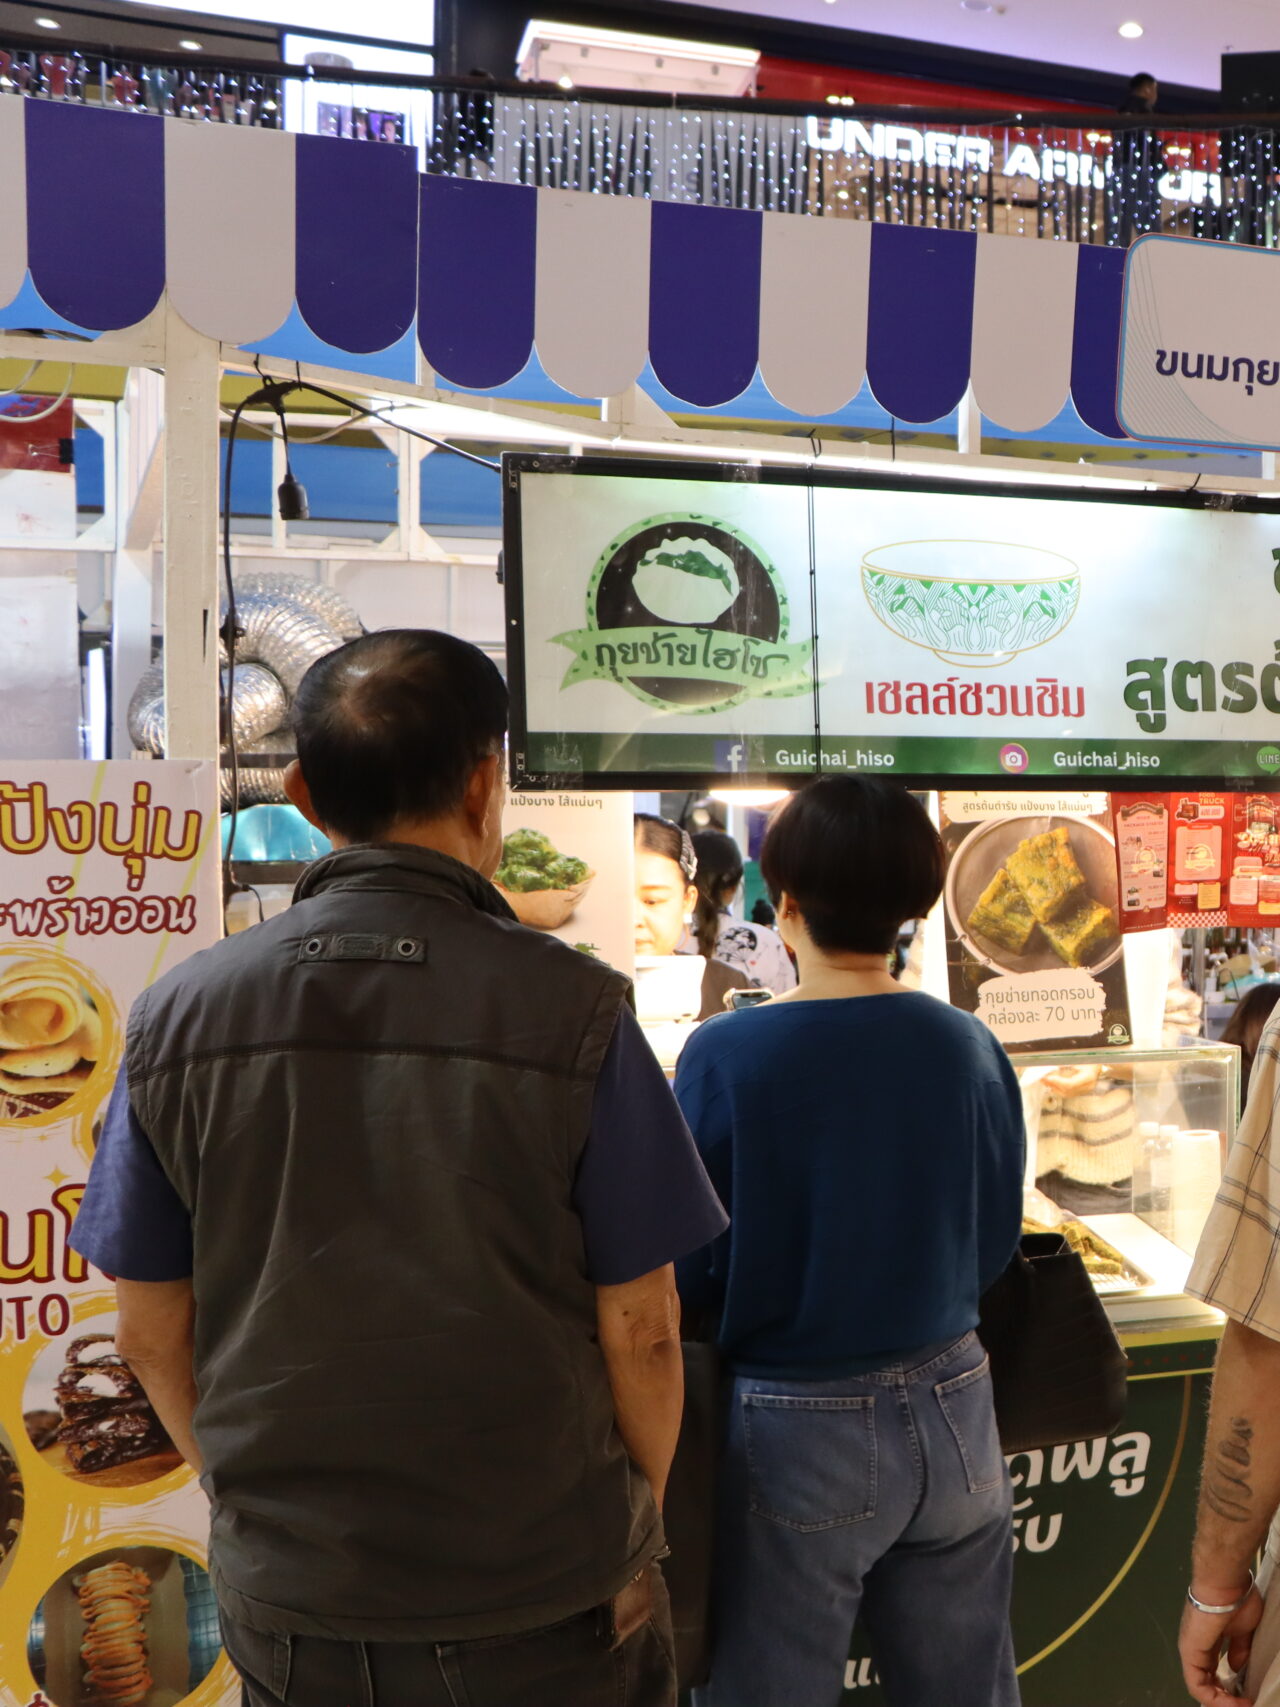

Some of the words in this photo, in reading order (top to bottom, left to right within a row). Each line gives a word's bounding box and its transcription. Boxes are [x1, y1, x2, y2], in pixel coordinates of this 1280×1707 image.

[805, 115, 991, 174] UNDER
[1002, 143, 1222, 207] ARMUR
[865, 676, 1087, 720] เชลล์ชวนชิม
[775, 749, 896, 769] Guichai_hiso
[1053, 751, 1161, 770] Guichai_hiso
[1258, 754, 1280, 765] LINE
[1200, 797, 1225, 805] TRUCK
[988, 1008, 1041, 1026] กล่องละ
[1045, 1006, 1066, 1022] 70
[1071, 1008, 1097, 1021] บาท
[0, 1293, 70, 1340] TO
